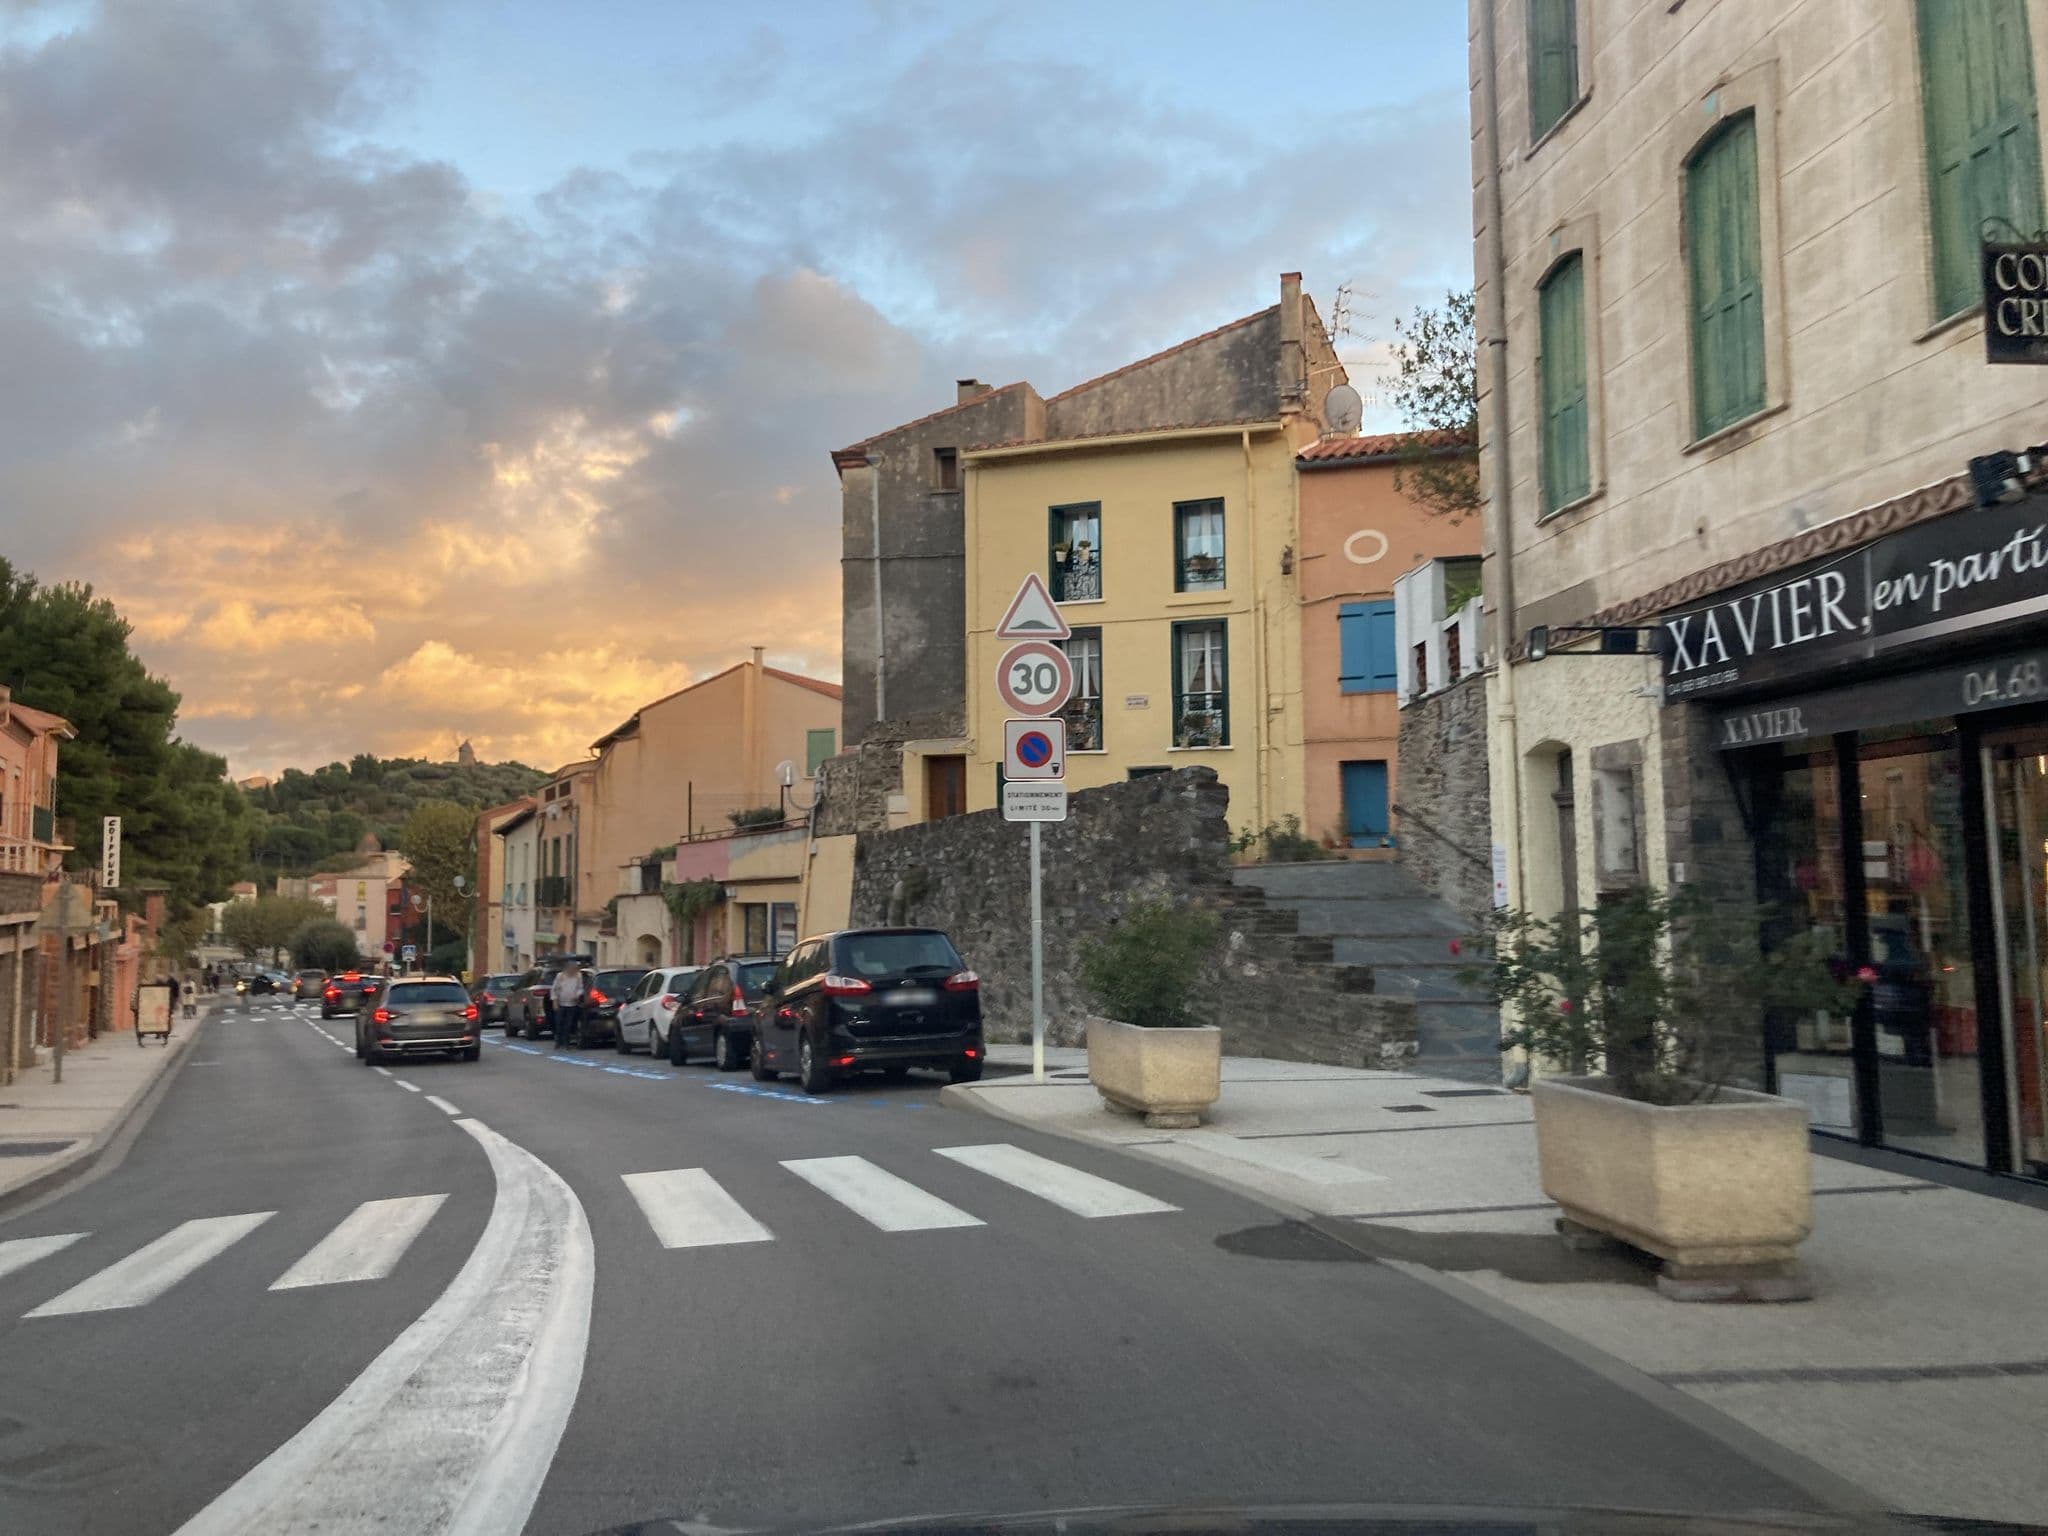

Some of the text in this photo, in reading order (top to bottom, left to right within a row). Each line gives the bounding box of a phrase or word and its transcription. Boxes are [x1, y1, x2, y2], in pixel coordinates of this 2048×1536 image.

[1873, 572, 1928, 612] en
[1012, 663, 1057, 695] 30
[107, 819, 117, 886] COIFFURE
